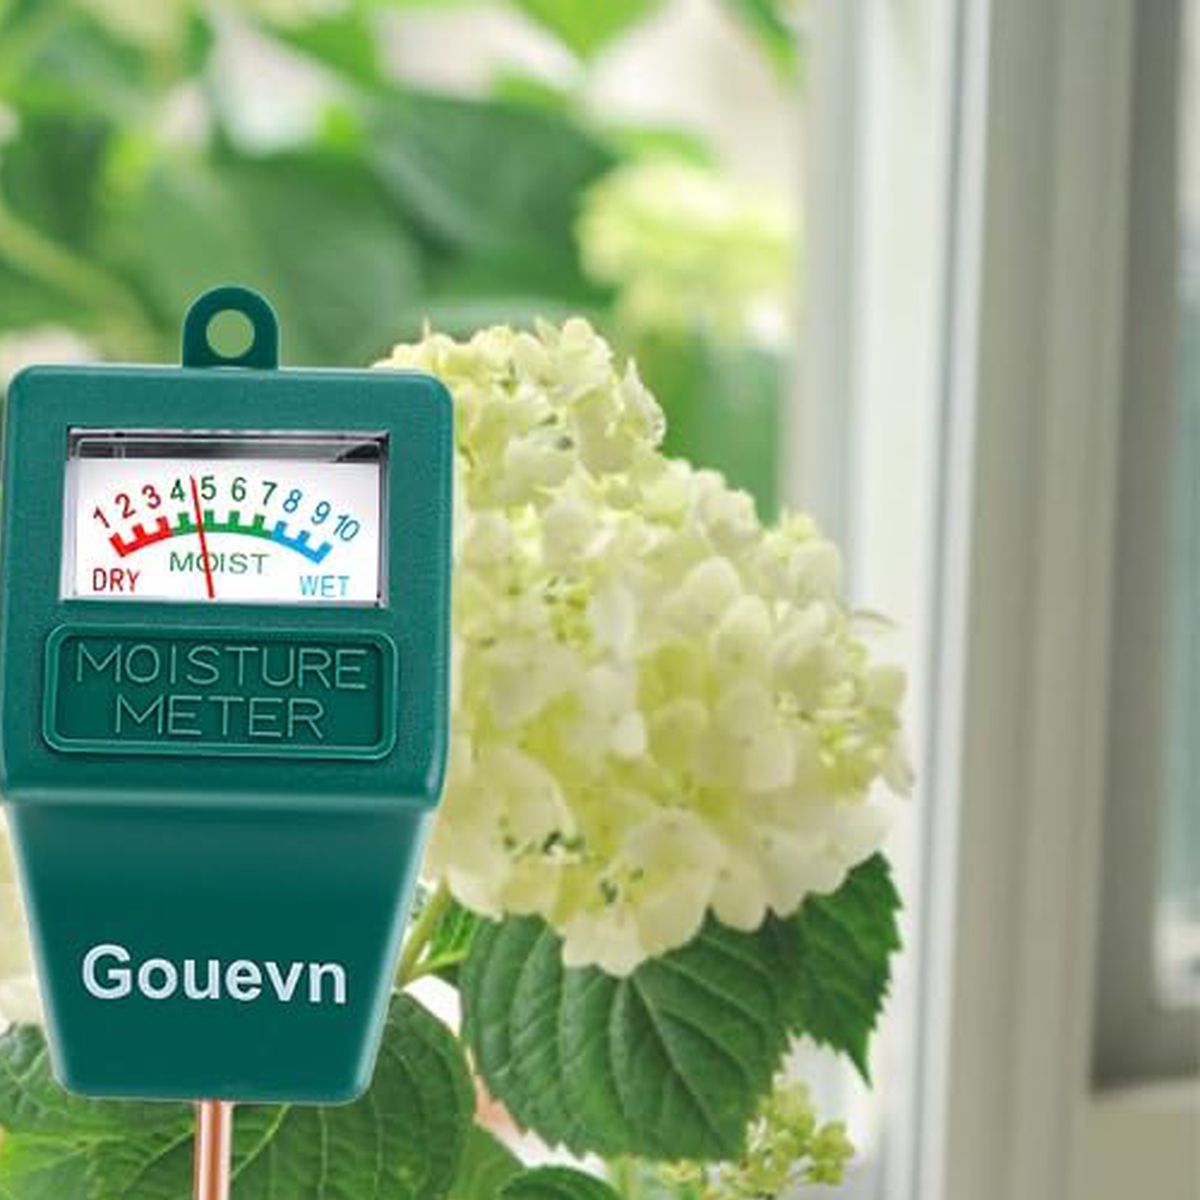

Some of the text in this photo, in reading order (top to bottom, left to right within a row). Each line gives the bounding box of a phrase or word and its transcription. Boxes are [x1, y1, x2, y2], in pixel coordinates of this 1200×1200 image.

[93, 475, 361, 542] 1 2 3 4 5 6 7 8 9 10
[92, 568, 140, 592] DRY
[169, 551, 270, 575] MOIST
[299, 574, 350, 598] WET
[76, 642, 368, 689] MOISTURE
[114, 693, 324, 739] METER
[82, 943, 347, 1004] Gouevn
